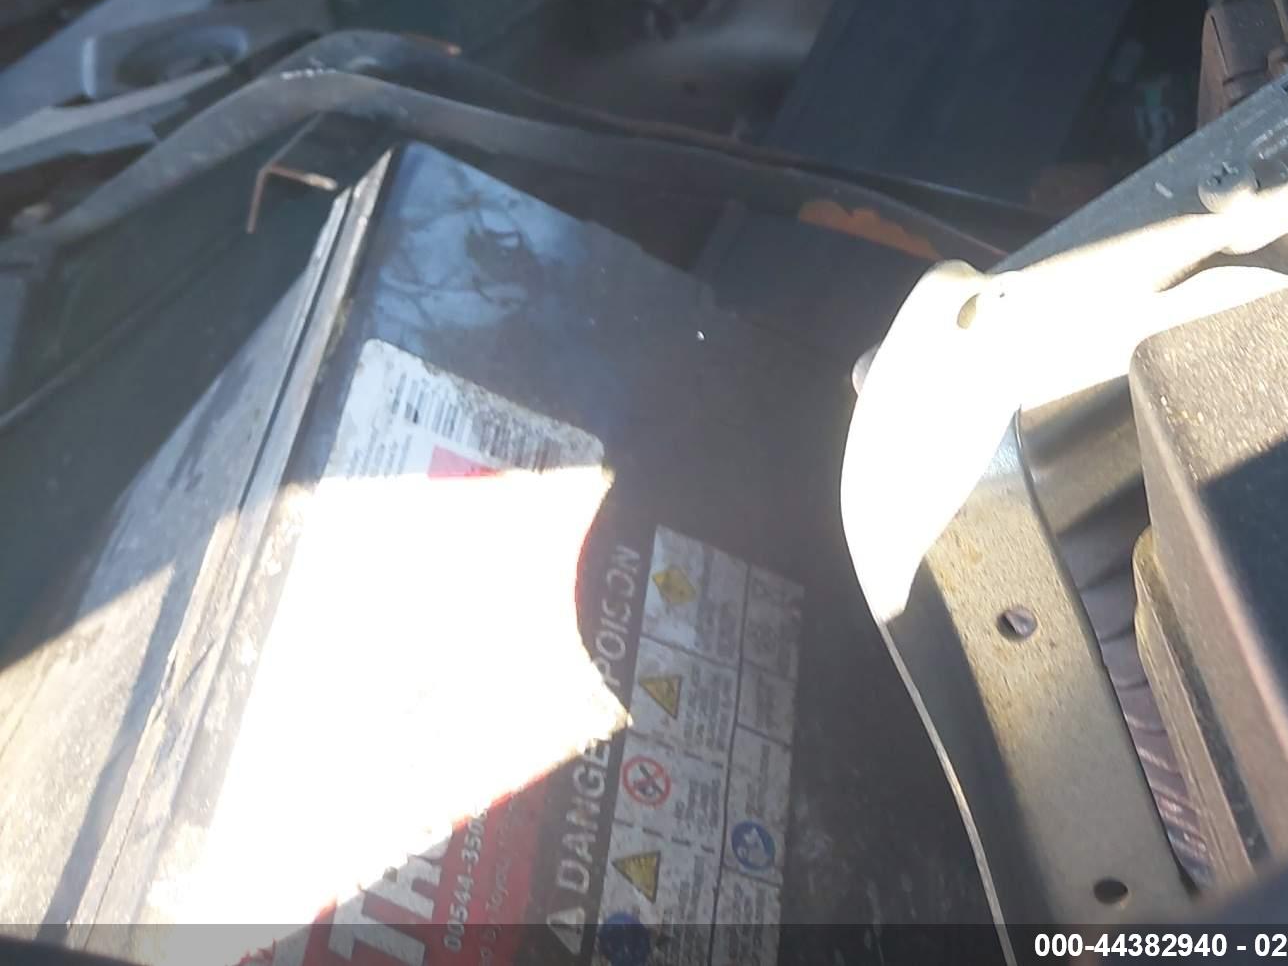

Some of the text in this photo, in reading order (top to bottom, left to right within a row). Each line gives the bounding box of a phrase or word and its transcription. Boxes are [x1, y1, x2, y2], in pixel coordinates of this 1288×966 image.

[556, 545, 641, 894] DANGE POISON
[443, 808, 488, 953] 00544-350
